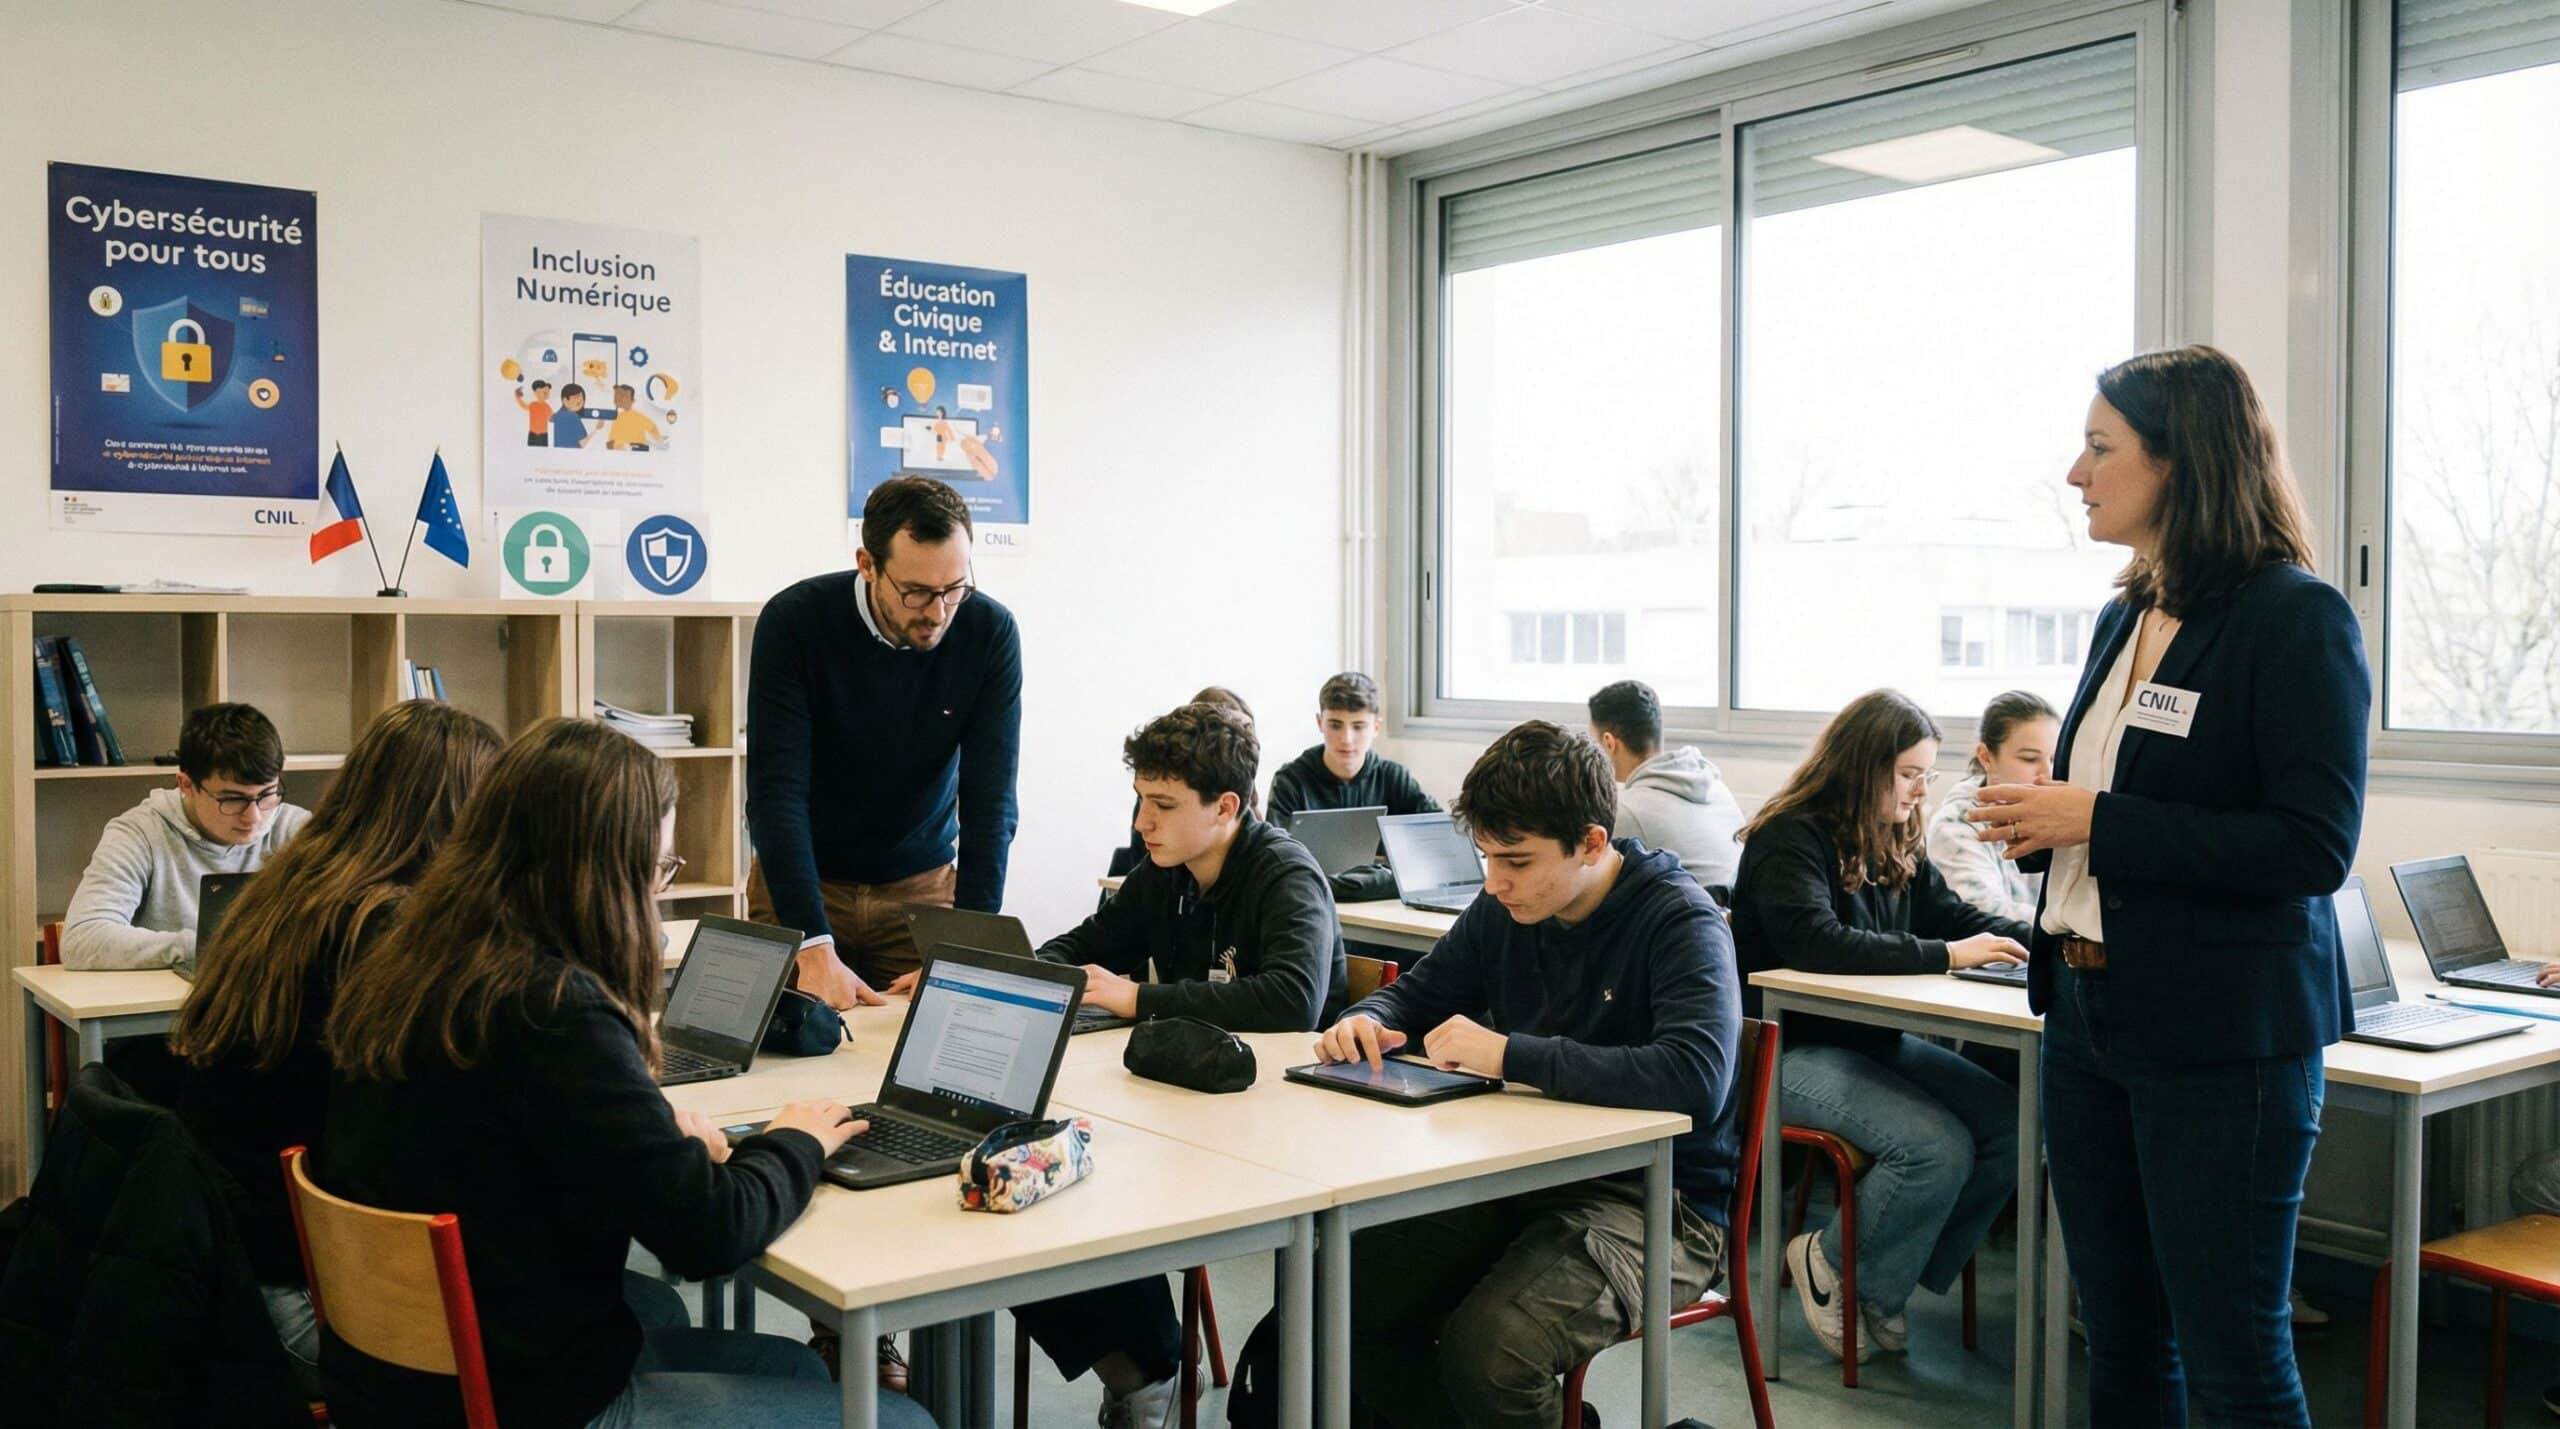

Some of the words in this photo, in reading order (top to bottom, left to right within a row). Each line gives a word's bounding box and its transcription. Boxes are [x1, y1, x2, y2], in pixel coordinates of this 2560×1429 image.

[65, 195, 303, 245] Cybersécurité
[105, 239, 186, 268] pour
[192, 244, 267, 275] tous
[531, 246, 656, 281] Inclusion
[517, 276, 671, 317] Numérique
[879, 268, 996, 308] Éducation
[893, 303, 983, 337] Civique
[878, 329, 898, 354] &
[904, 332, 998, 362] Internet
